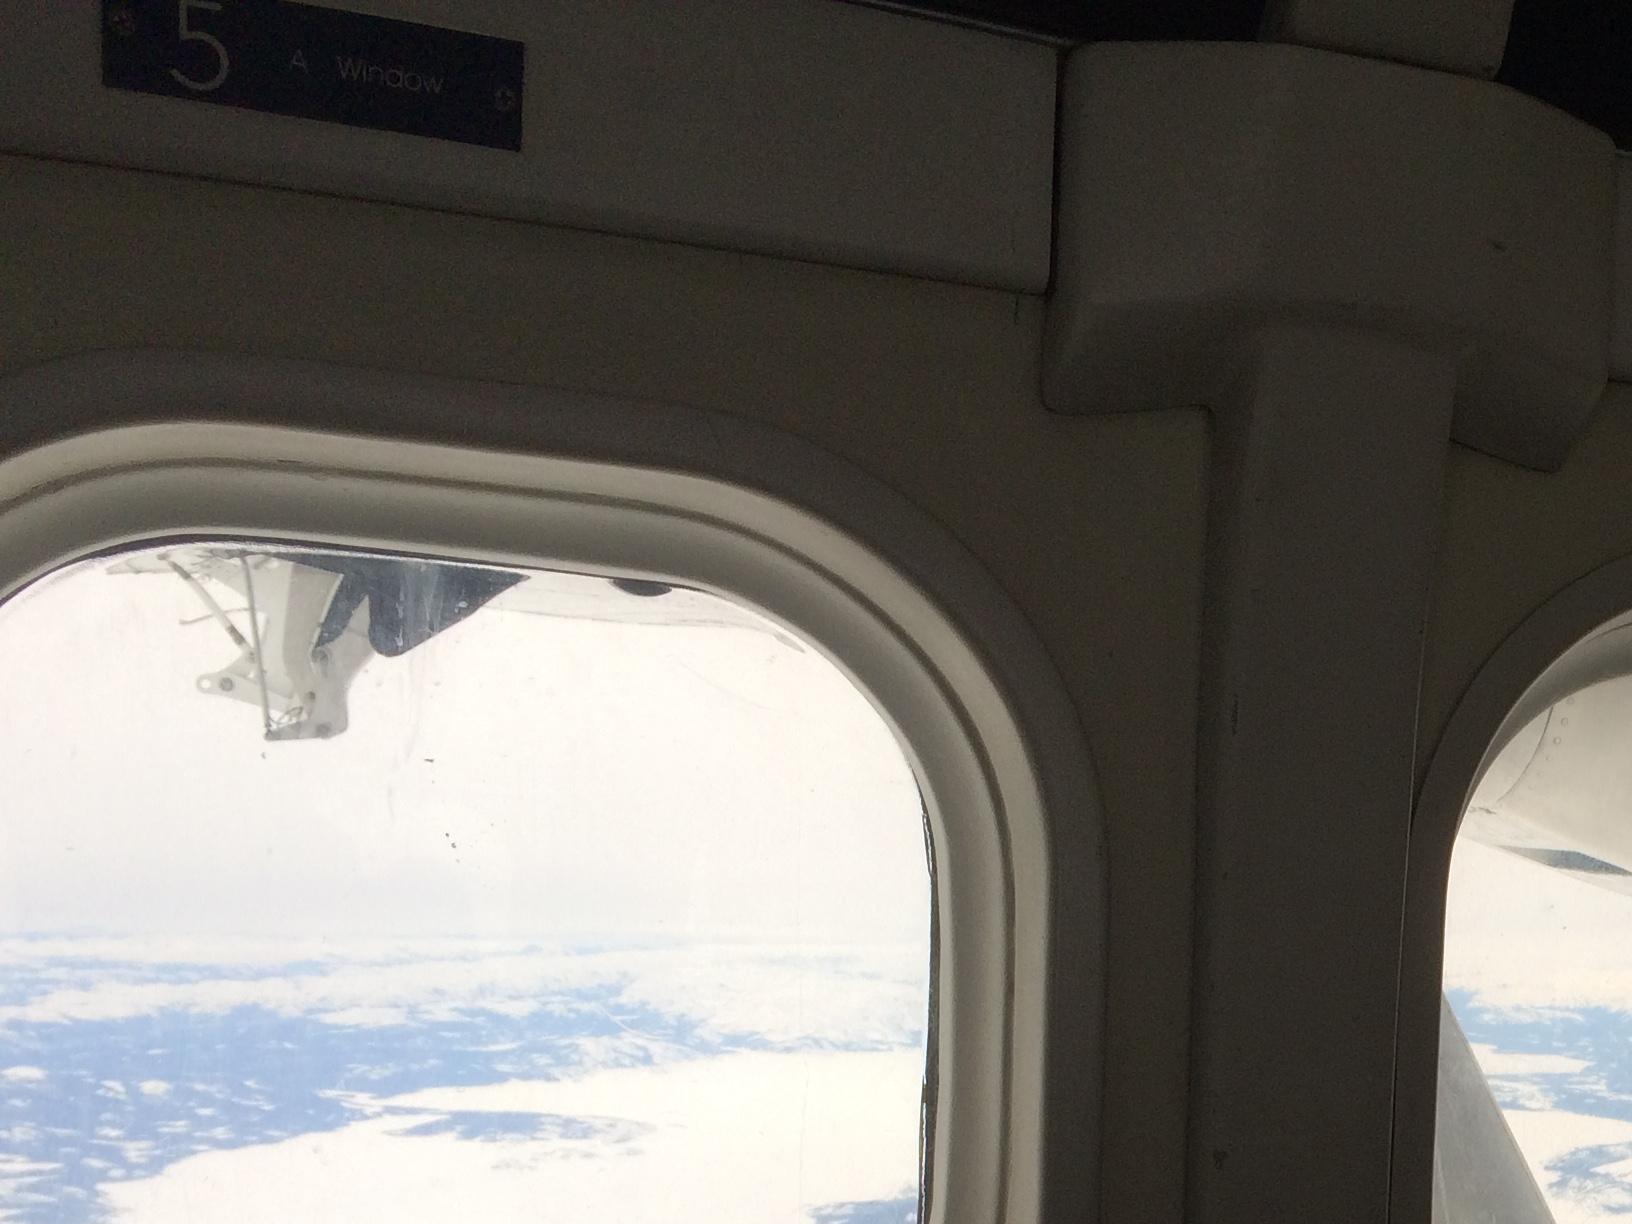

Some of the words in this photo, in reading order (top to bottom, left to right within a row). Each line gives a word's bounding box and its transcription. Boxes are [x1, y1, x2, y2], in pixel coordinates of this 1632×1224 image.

[171, 0, 230, 91] 5
[289, 49, 309, 74] A
[336, 56, 446, 97] Window
